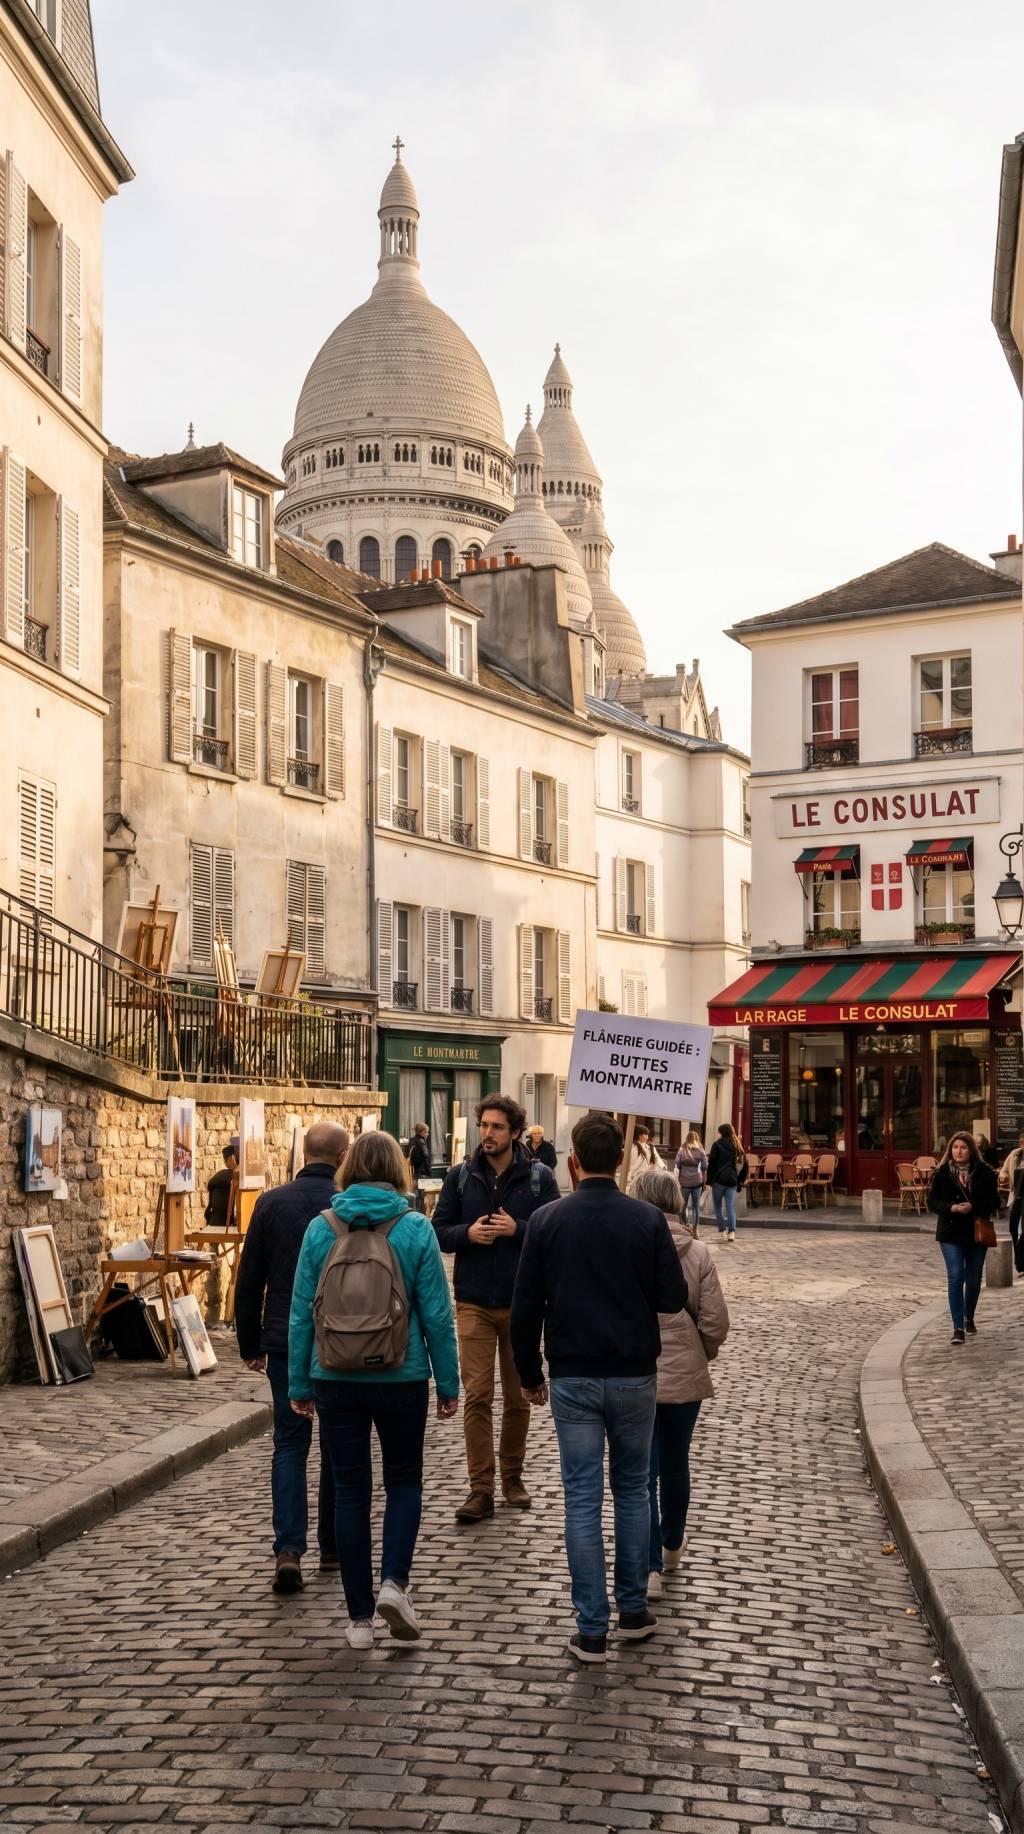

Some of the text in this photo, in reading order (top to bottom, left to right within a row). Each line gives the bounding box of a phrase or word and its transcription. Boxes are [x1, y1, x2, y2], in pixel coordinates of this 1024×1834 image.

[791, 788, 980, 828] LE CONSULAT
[839, 1007, 859, 1021] LE
[864, 1004, 957, 1020] CONSULAT
[413, 1046, 480, 1060] LE MONTMARTRE
[583, 1029, 643, 1048] FLÂNERIE
[645, 1038, 693, 1055] GUIDÉE
[609, 1053, 669, 1073] BUTTES
[579, 1068, 693, 1096] MONTMARTRE
